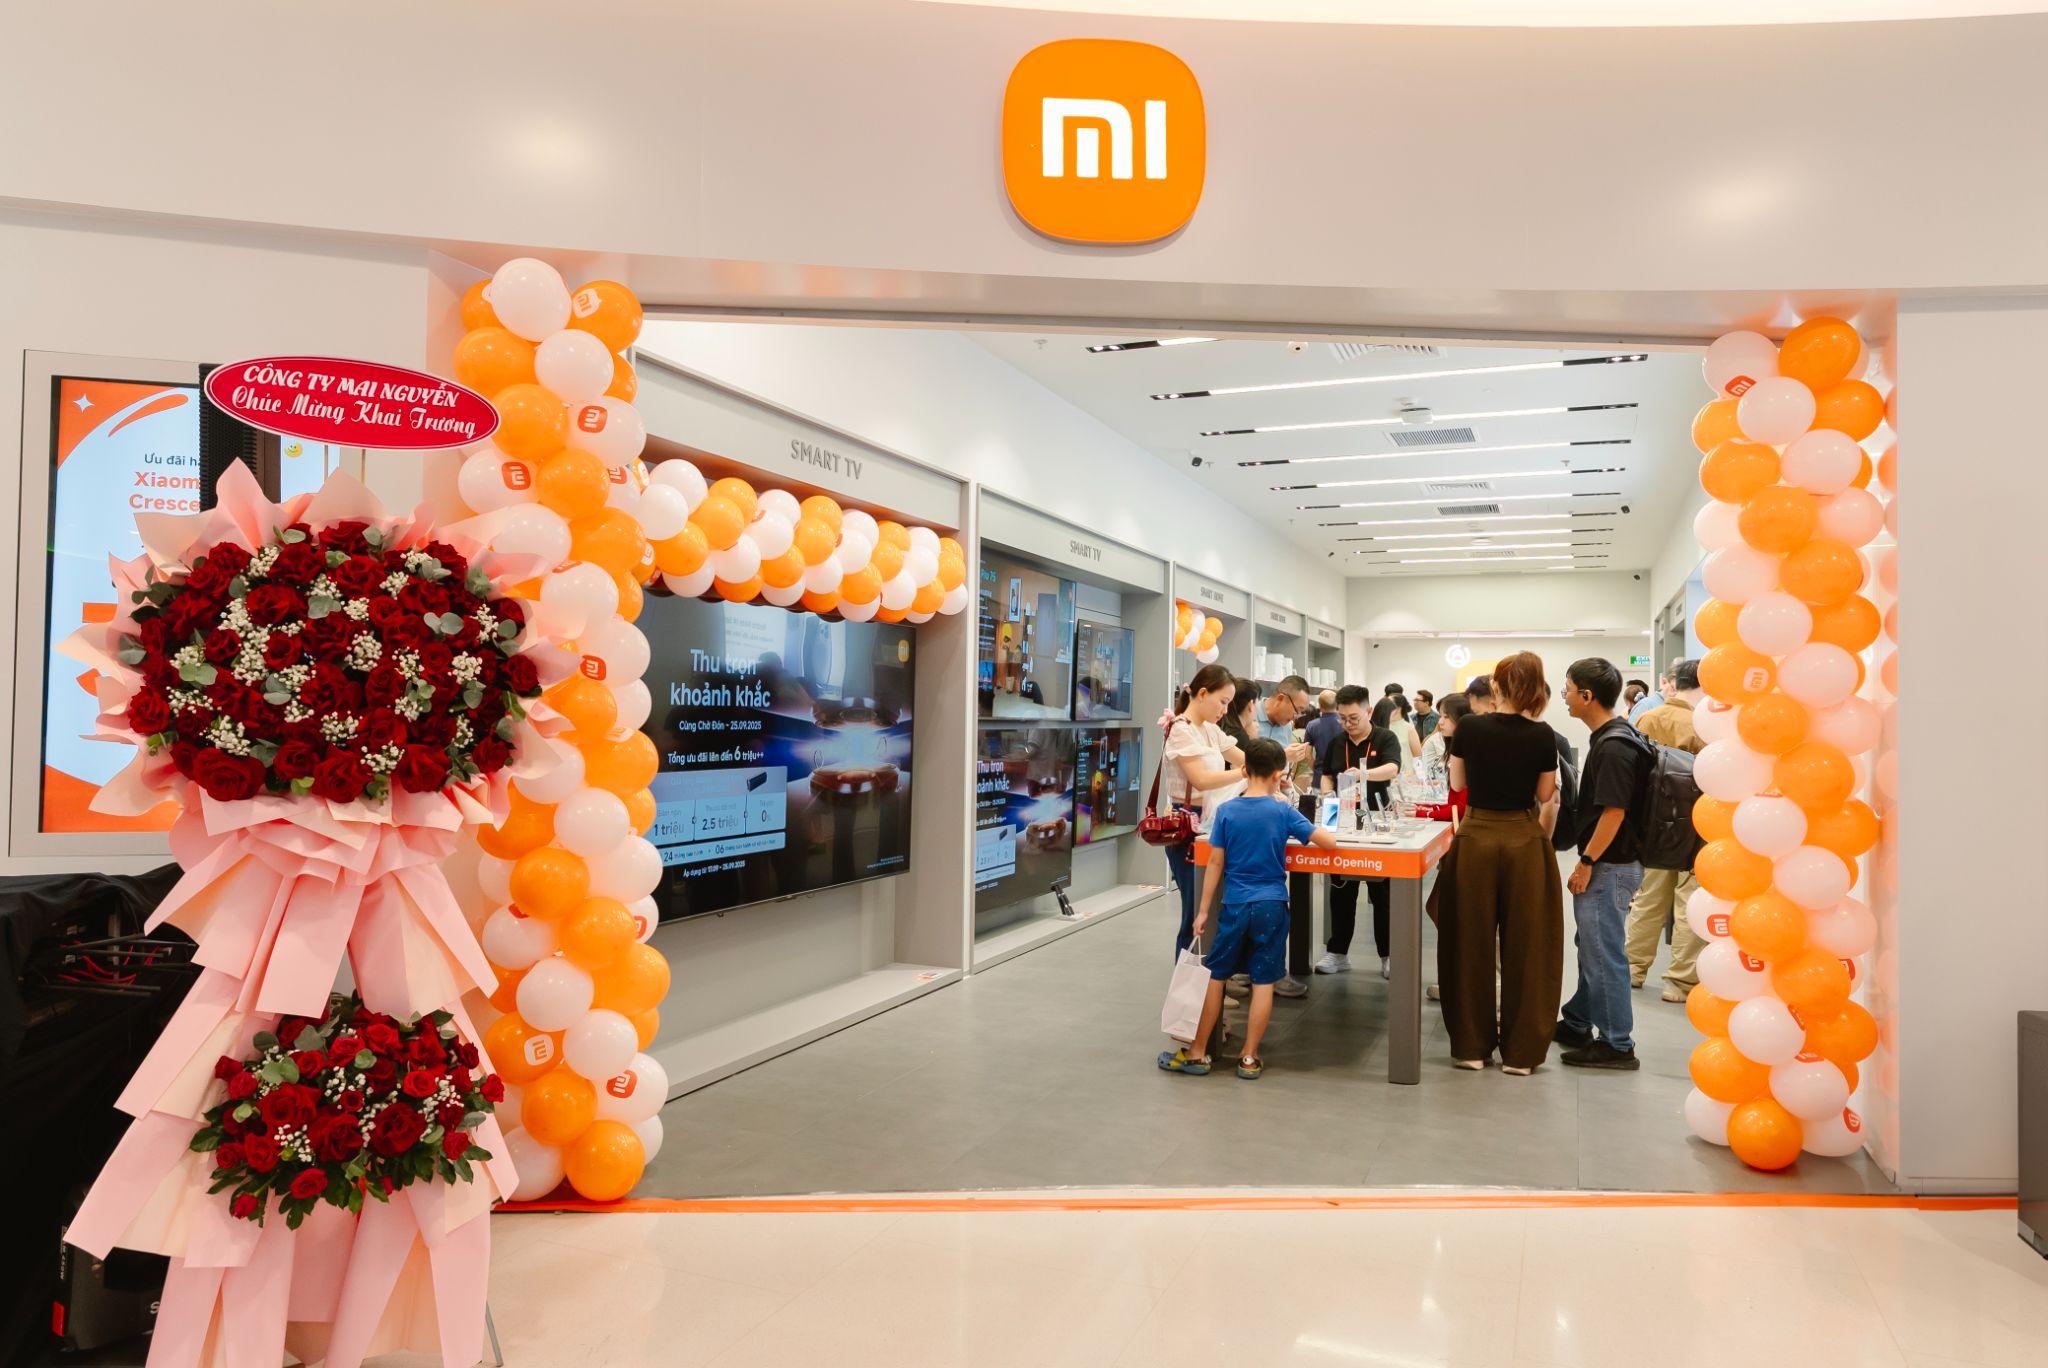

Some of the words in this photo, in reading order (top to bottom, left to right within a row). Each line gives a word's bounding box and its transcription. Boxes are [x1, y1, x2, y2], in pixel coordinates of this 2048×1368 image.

[243, 363, 303, 389] CÔNG
[307, 372, 336, 392] TY
[336, 377, 378, 398] MAI
[379, 382, 459, 407] NGUYỄN
[231, 385, 281, 413] Chúc
[286, 393, 345, 425] Mừng
[351, 400, 402, 427] Khai
[409, 407, 476, 439] Trương
[144, 453, 163, 465] Ưu
[166, 455, 186, 466] đãi
[791, 439, 841, 473] SMART
[844, 457, 863, 480] TV
[134, 471, 200, 489] Xiaom
[129, 493, 200, 511] Cresce
[1070, 539, 1091, 559] SMART
[1092, 547, 1102, 561] TV
[690, 649, 720, 673] Thu
[725, 653, 756, 680] trọn
[670, 681, 732, 707] khoảnh
[735, 680, 771, 708] khắc
[679, 720, 697, 732] Cùng
[730, 720, 762, 730] 25.09.2025
[668, 751, 685, 765] Tổng
[734, 746, 741, 760] 6
[977, 778, 993, 794] oảnh
[702, 817, 716, 831] 2.5
[664, 851, 673, 862] 24
[715, 844, 725, 854] 06
[1295, 854, 1330, 866] Grand
[1333, 855, 1383, 871] Opening
